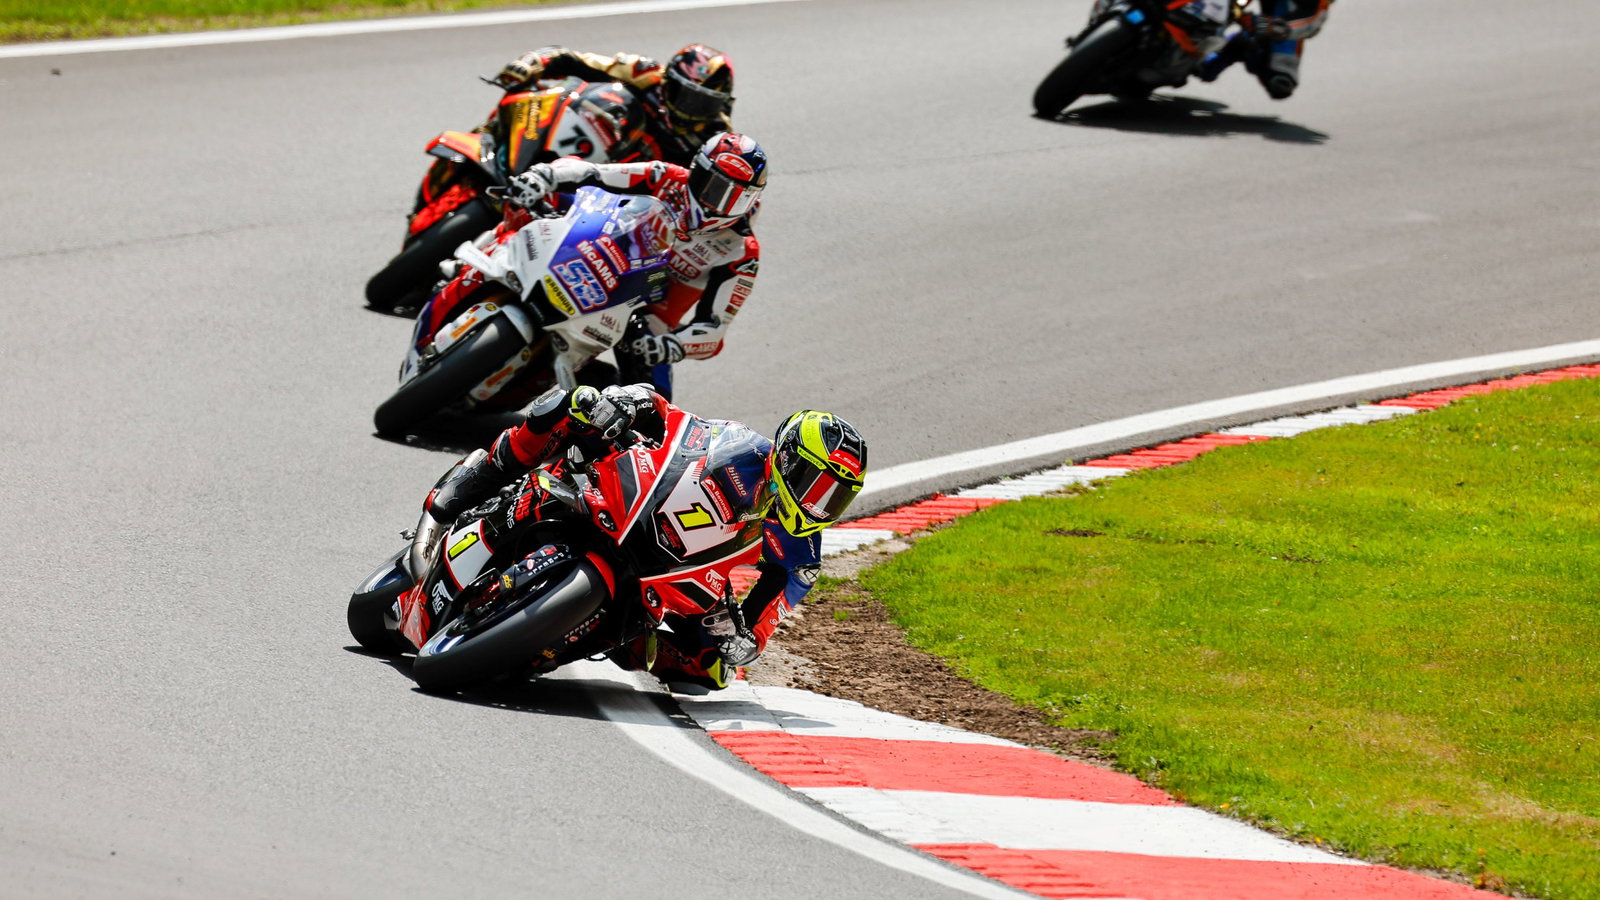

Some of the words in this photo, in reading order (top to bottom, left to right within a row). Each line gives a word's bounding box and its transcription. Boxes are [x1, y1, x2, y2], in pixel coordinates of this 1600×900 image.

[577, 240, 617, 289] McAMS
[553, 258, 608, 311] 52
[727, 465, 749, 497] bitubo
[673, 502, 717, 532] 1
[714, 490, 732, 520] Bennetts
[448, 531, 480, 559] 1
[705, 570, 724, 592] OMG
